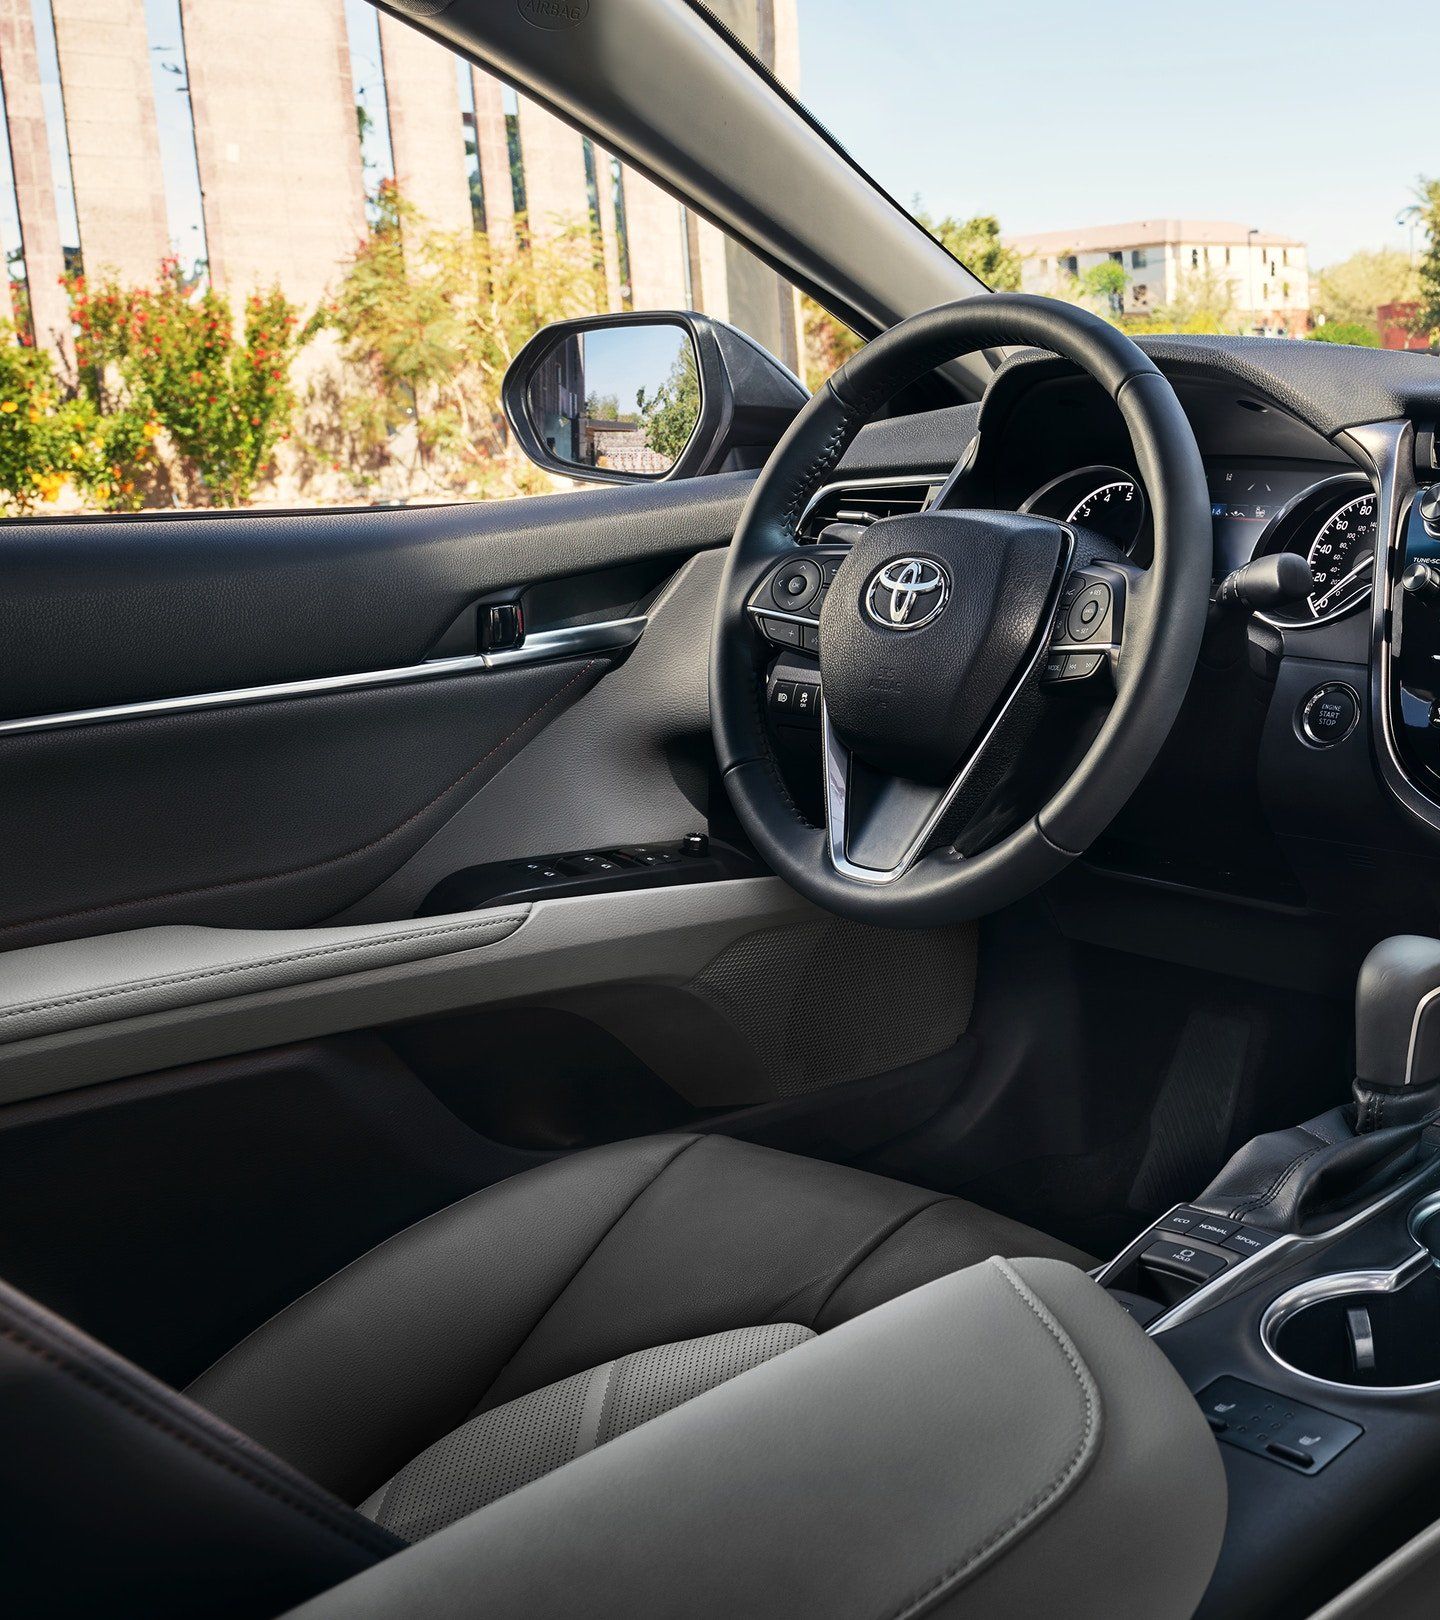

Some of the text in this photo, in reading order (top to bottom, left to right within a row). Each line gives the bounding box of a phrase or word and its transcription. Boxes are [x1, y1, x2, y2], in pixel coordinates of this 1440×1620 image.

[523, 0, 582, 19] AIRBAG
[1103, 493, 1111, 502] 4
[1125, 492, 1133, 501] 5
[1083, 508, 1091, 517] 3
[1359, 505, 1372, 516] 80
[1335, 520, 1349, 531] 60
[1319, 544, 1332, 555] 40
[1313, 572, 1327, 583] 20
[1320, 597, 1328, 608] 0
[1321, 703, 1342, 711] ENGINE
[1319, 710, 1340, 719] START
[1318, 718, 1337, 726] STOP
[1199, 1223, 1228, 1235] NORMAL
[1234, 1234, 1261, 1247] SPORT
[1172, 1253, 1191, 1262] HOLD
